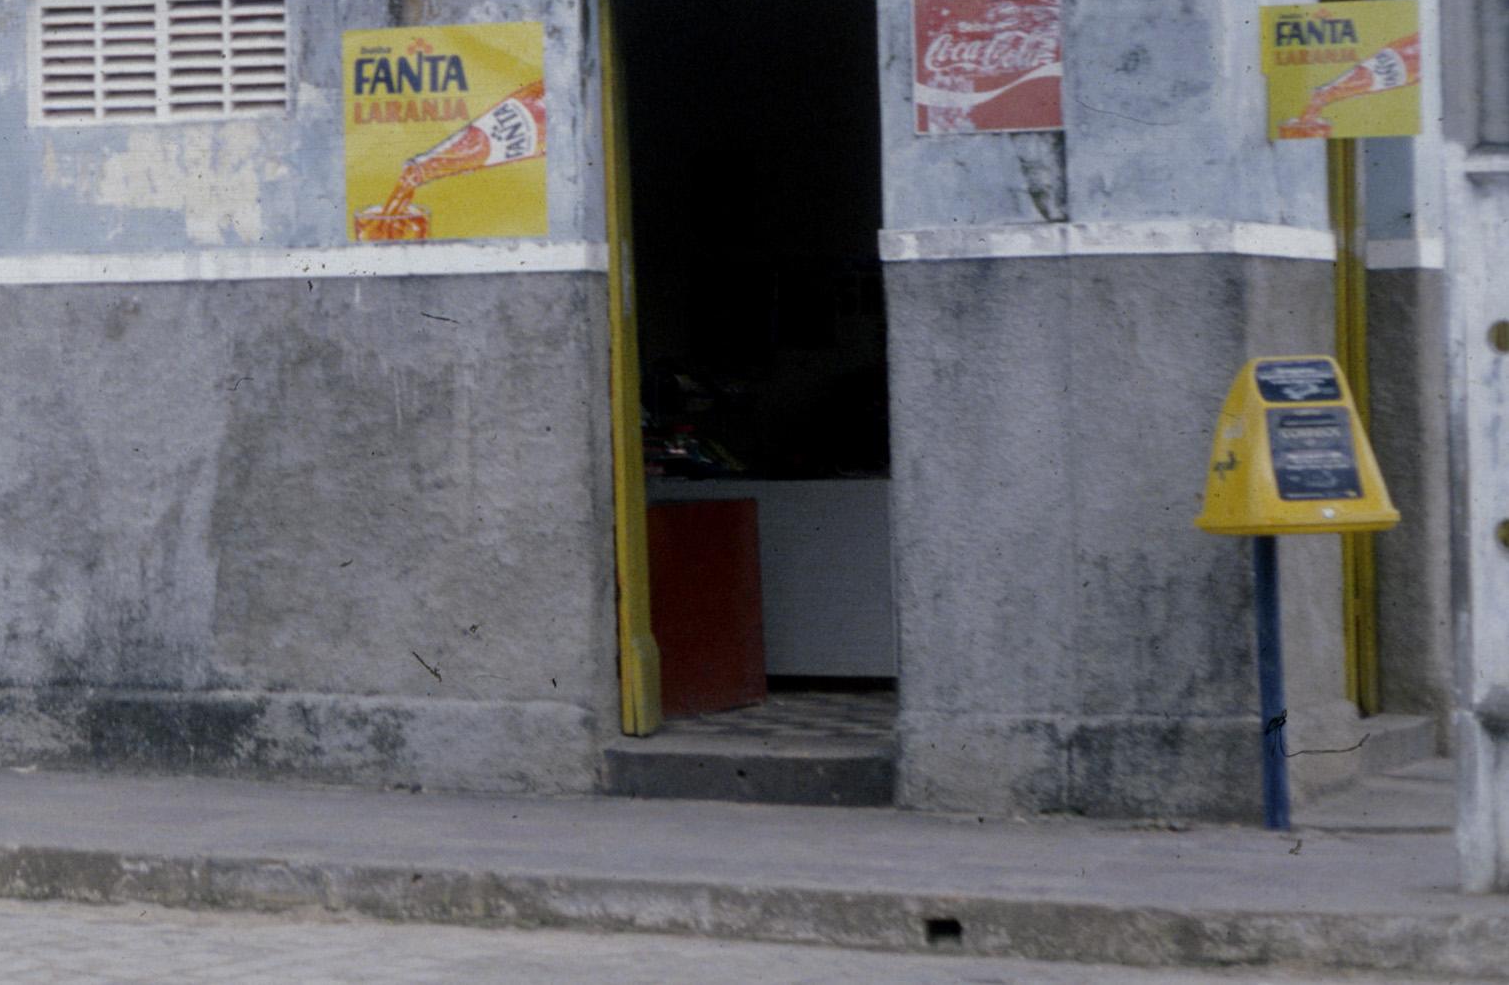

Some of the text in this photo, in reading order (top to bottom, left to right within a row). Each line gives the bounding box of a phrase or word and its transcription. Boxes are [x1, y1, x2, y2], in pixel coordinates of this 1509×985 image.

[1274, 18, 1359, 47] FANTA
[353, 50, 469, 95] FANTA
[354, 98, 469, 125] LARANJA
